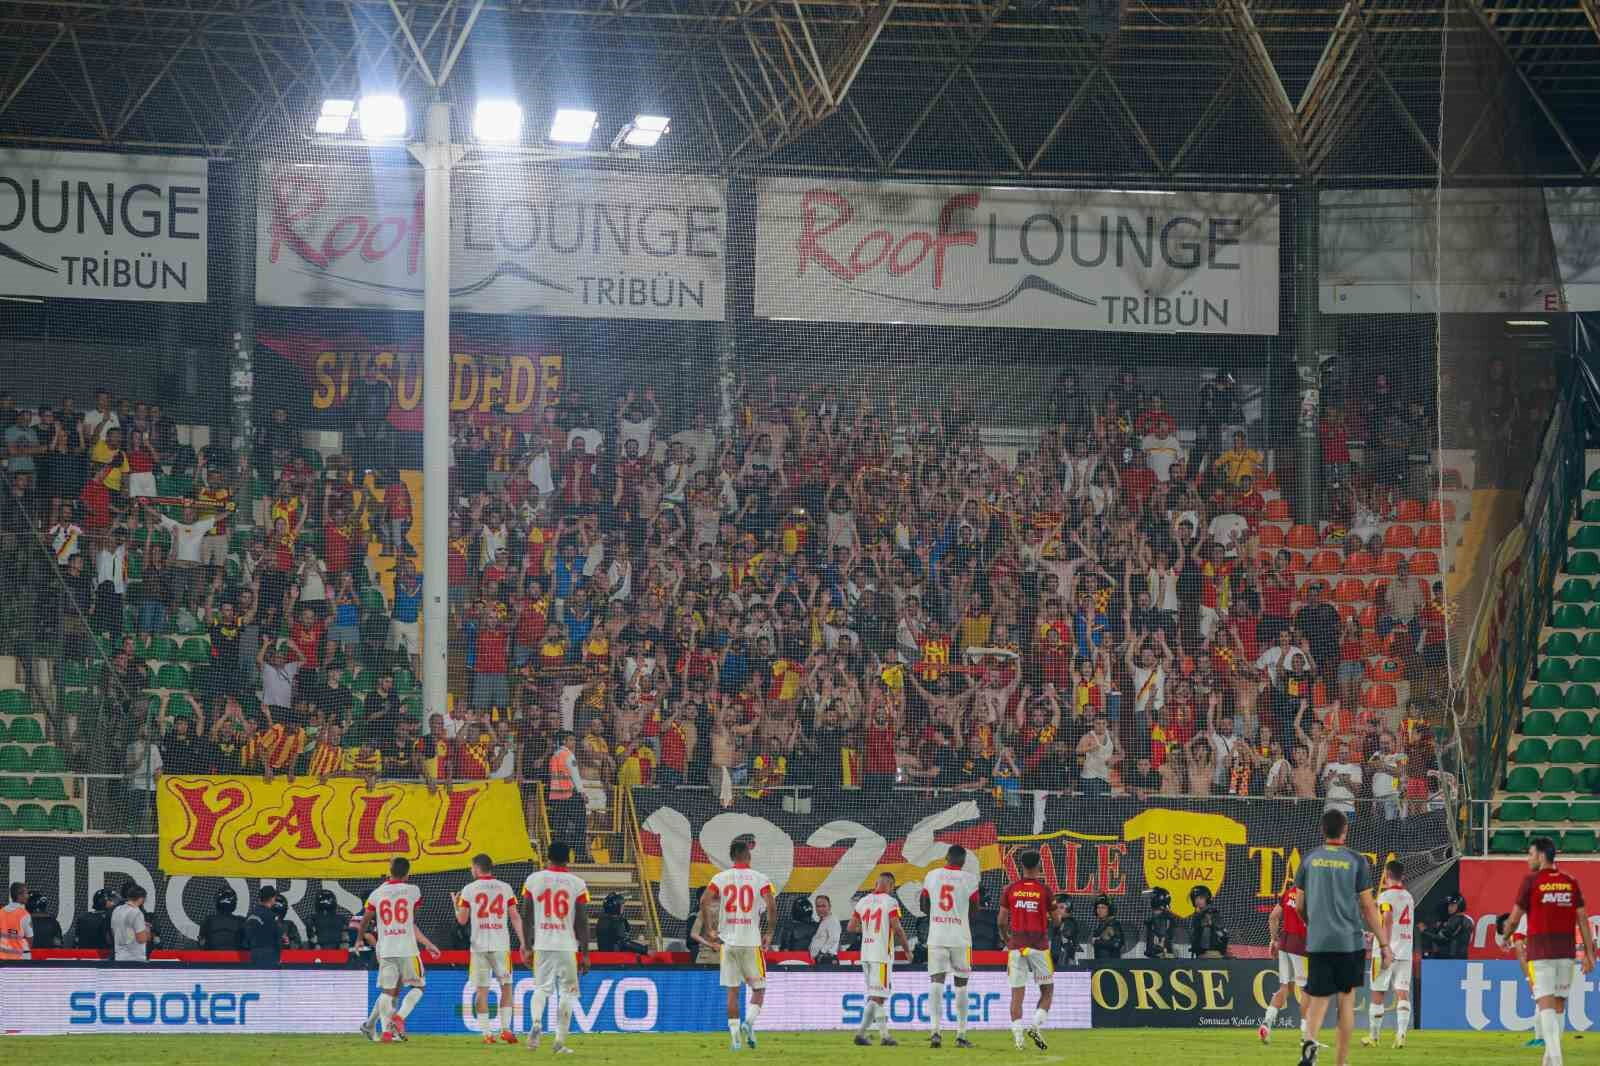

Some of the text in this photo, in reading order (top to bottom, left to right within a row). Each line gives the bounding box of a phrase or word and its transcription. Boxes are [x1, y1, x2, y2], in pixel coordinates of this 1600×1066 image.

[463, 198, 721, 257] LOUNGE
[798, 189, 1240, 289] Roof LOUNGE
[61, 251, 187, 289] TRİBÜN
[576, 270, 705, 308] TRİBÜN
[1102, 290, 1229, 327] TRİBÜN
[1147, 832, 1224, 848] BU SEVDA
[642, 800, 981, 920] 1925
[1147, 848, 1225, 865] BU ŞEHRE
[1155, 864, 1214, 881] SIĞMAZ
[380, 898, 408, 925] 66
[475, 893, 504, 919] 24
[538, 888, 569, 919] 16
[723, 884, 754, 912] 20
[938, 884, 954, 912] 5
[1541, 893, 1572, 903] AVEC
[861, 907, 883, 933] 11
[1399, 904, 1411, 925] 4
[70, 984, 260, 1025] scooter
[842, 984, 1000, 1024] sooter
[1091, 968, 1234, 1011] ORSE
[1461, 963, 1600, 1032] tut
